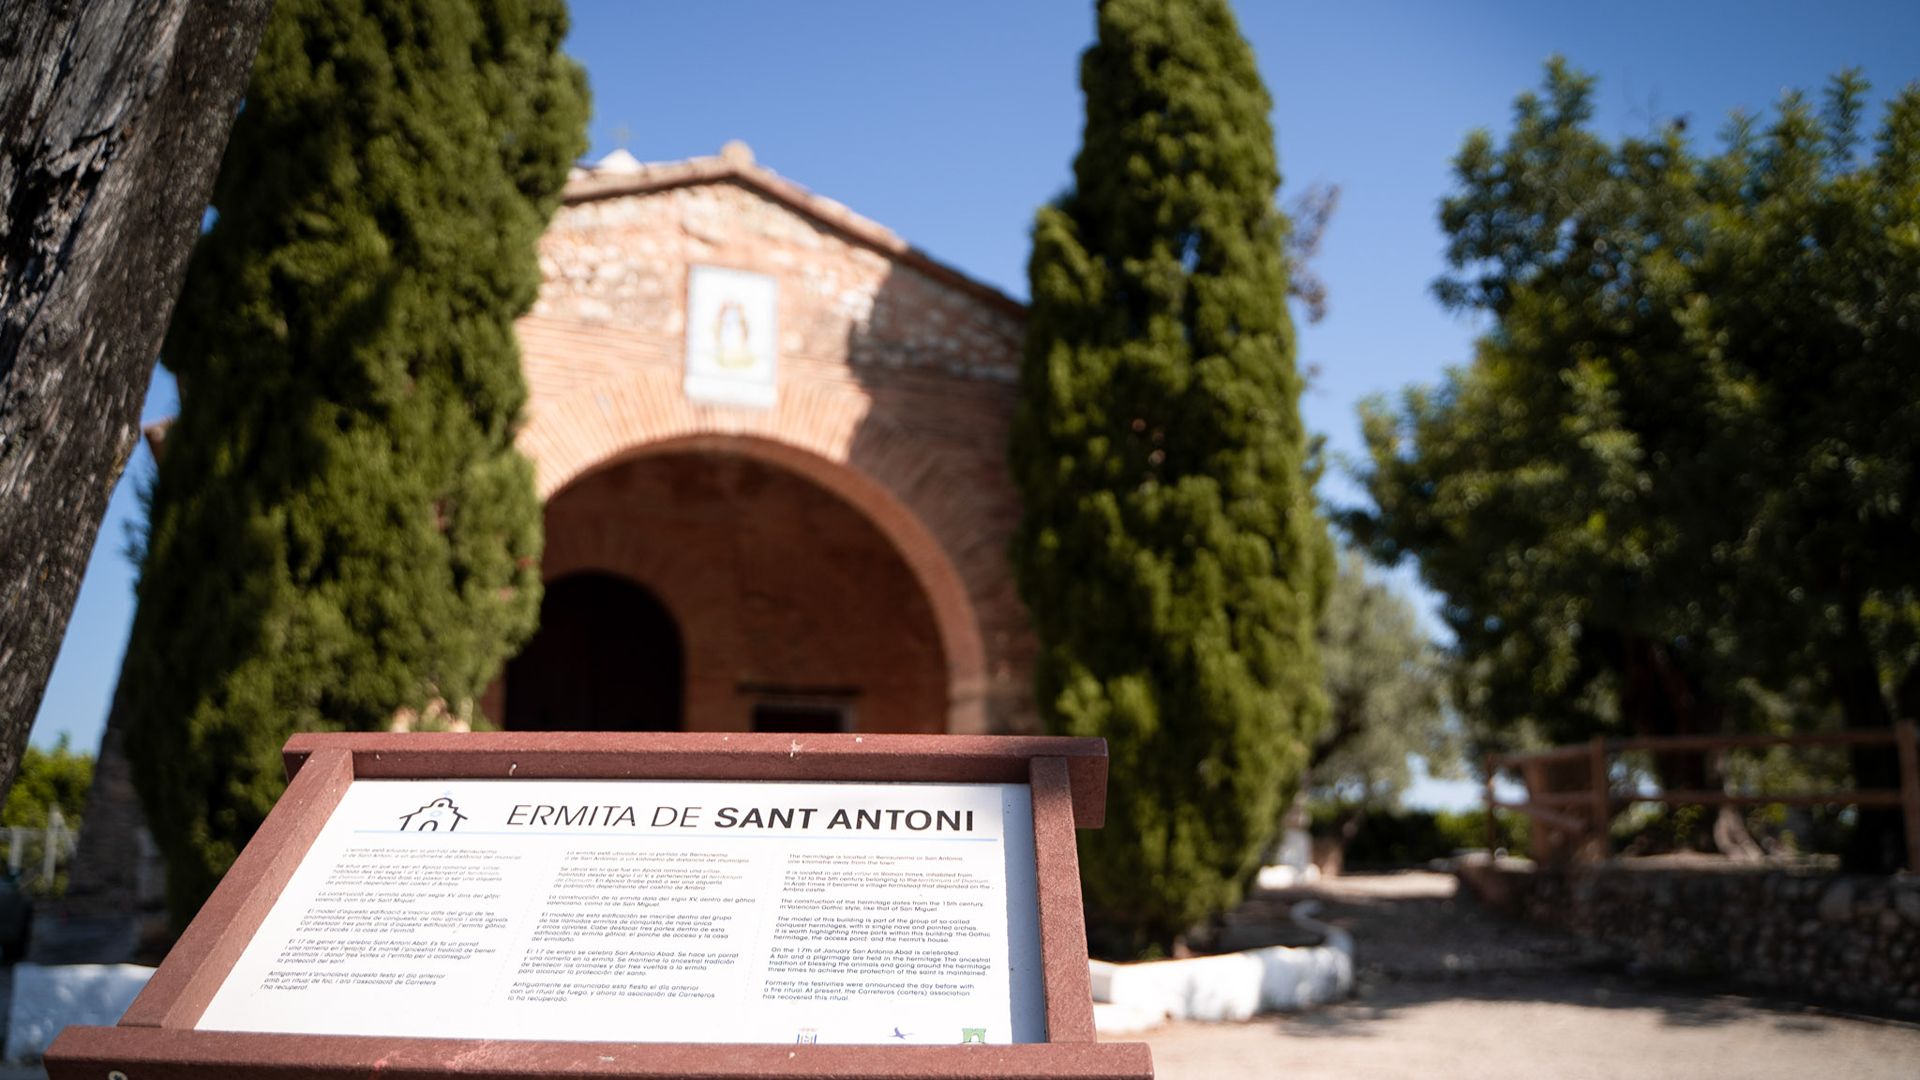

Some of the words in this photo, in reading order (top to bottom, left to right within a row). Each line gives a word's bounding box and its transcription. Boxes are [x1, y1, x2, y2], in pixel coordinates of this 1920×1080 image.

[506, 804, 636, 827] ERMITA
[650, 806, 702, 828] DE
[714, 807, 819, 830] SANT
[826, 808, 974, 832] ANTONI
